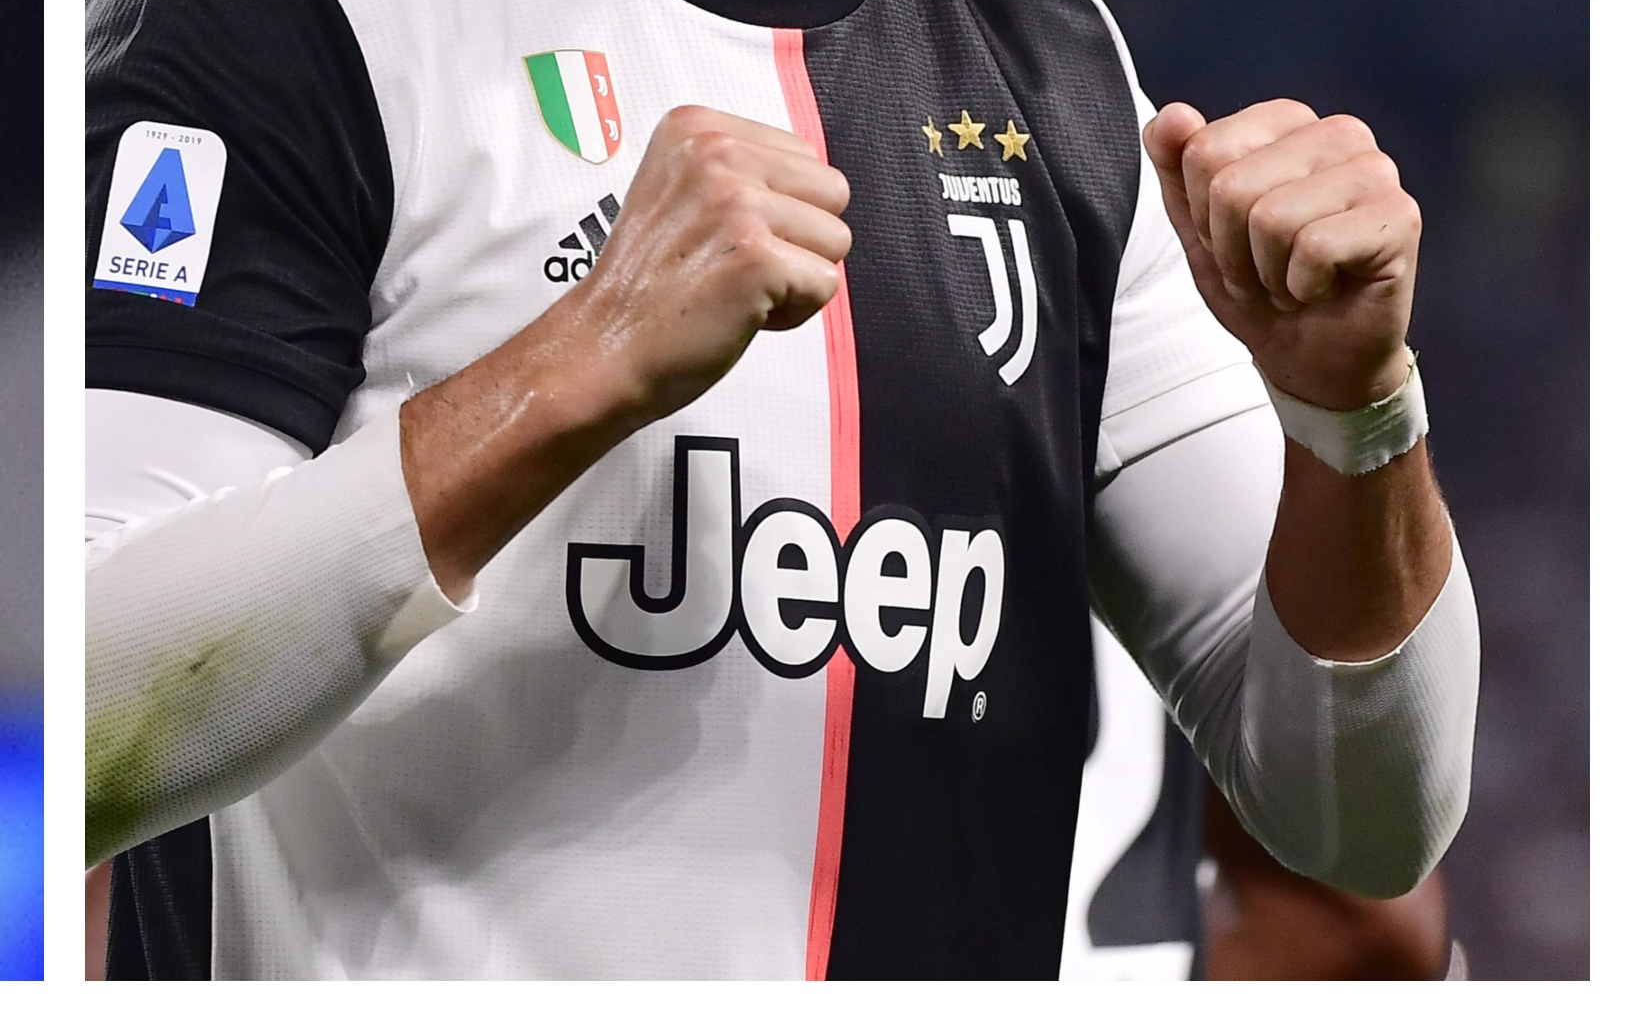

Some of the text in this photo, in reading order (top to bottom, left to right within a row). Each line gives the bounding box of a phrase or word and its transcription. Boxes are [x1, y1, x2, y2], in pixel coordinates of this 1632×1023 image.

[146, 130, 168, 140] 1929
[178, 134, 202, 145] 2019
[938, 173, 1022, 206] JUVENTUS
[109, 256, 187, 283] SERIE A
[544, 250, 599, 283] ad
[566, 435, 1005, 719] Jeep
